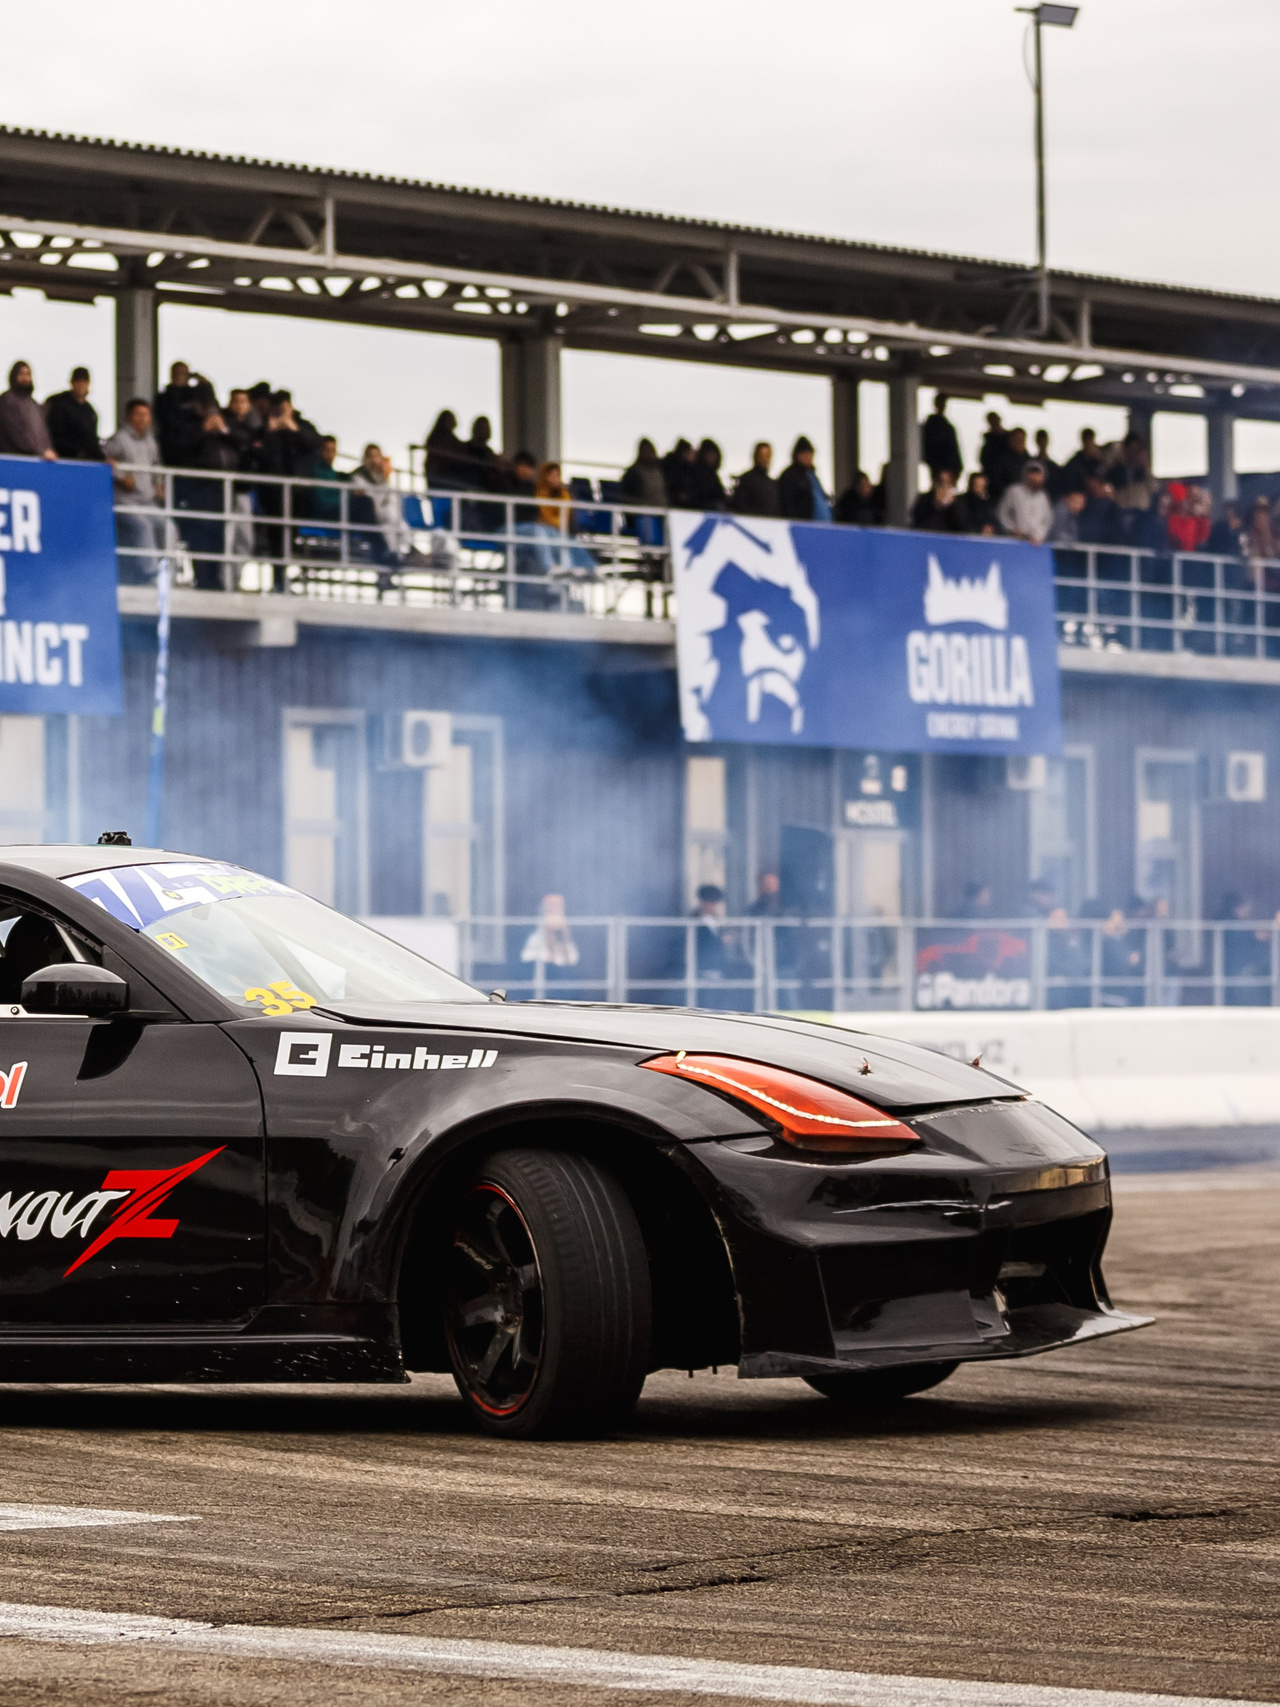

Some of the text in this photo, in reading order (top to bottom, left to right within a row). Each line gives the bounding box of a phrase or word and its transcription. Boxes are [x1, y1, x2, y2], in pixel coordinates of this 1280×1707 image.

[906, 629, 1035, 708] GORILLA
[244, 980, 318, 1017] 35
[337, 1042, 499, 1070] Einhell
